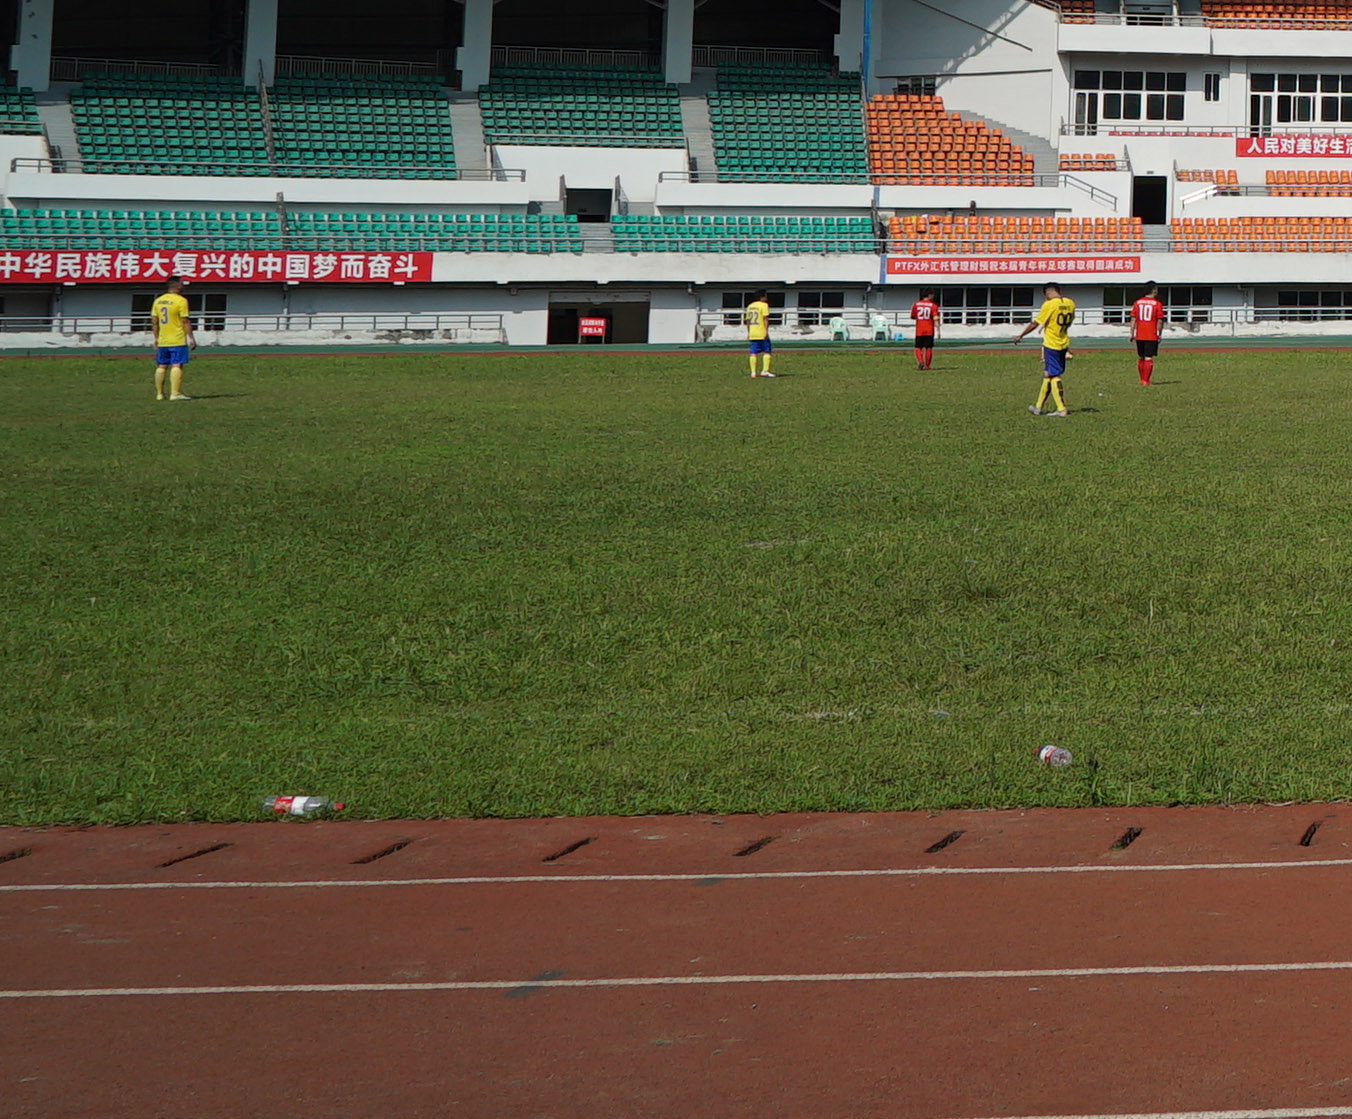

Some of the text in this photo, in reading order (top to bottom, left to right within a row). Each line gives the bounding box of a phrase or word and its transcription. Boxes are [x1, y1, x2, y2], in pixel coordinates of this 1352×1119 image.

[0, 252, 418, 279] 中华民族伟大复兴的中国梦而奋斗
[160, 306, 169, 325] 3
[916, 306, 931, 320] 20
[1138, 304, 1153, 321] 10
